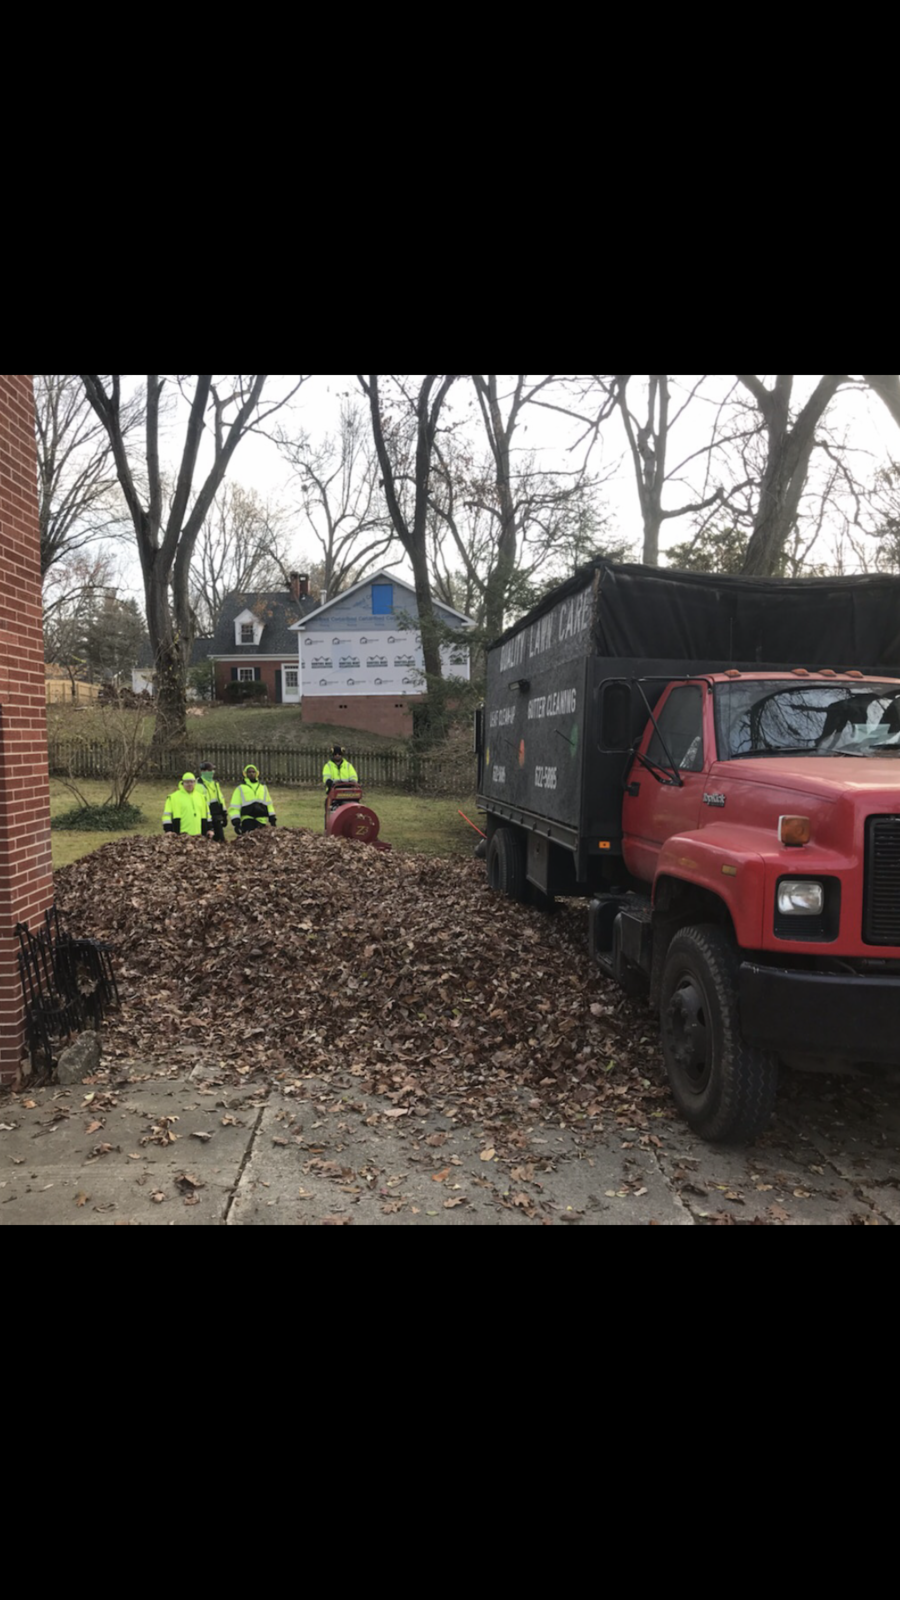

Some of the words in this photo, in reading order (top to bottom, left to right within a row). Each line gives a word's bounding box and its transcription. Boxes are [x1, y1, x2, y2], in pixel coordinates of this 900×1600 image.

[559, 587, 592, 641] CARE
[528, 696, 546, 719] GUTTER
[546, 688, 577, 716] CLEANING
